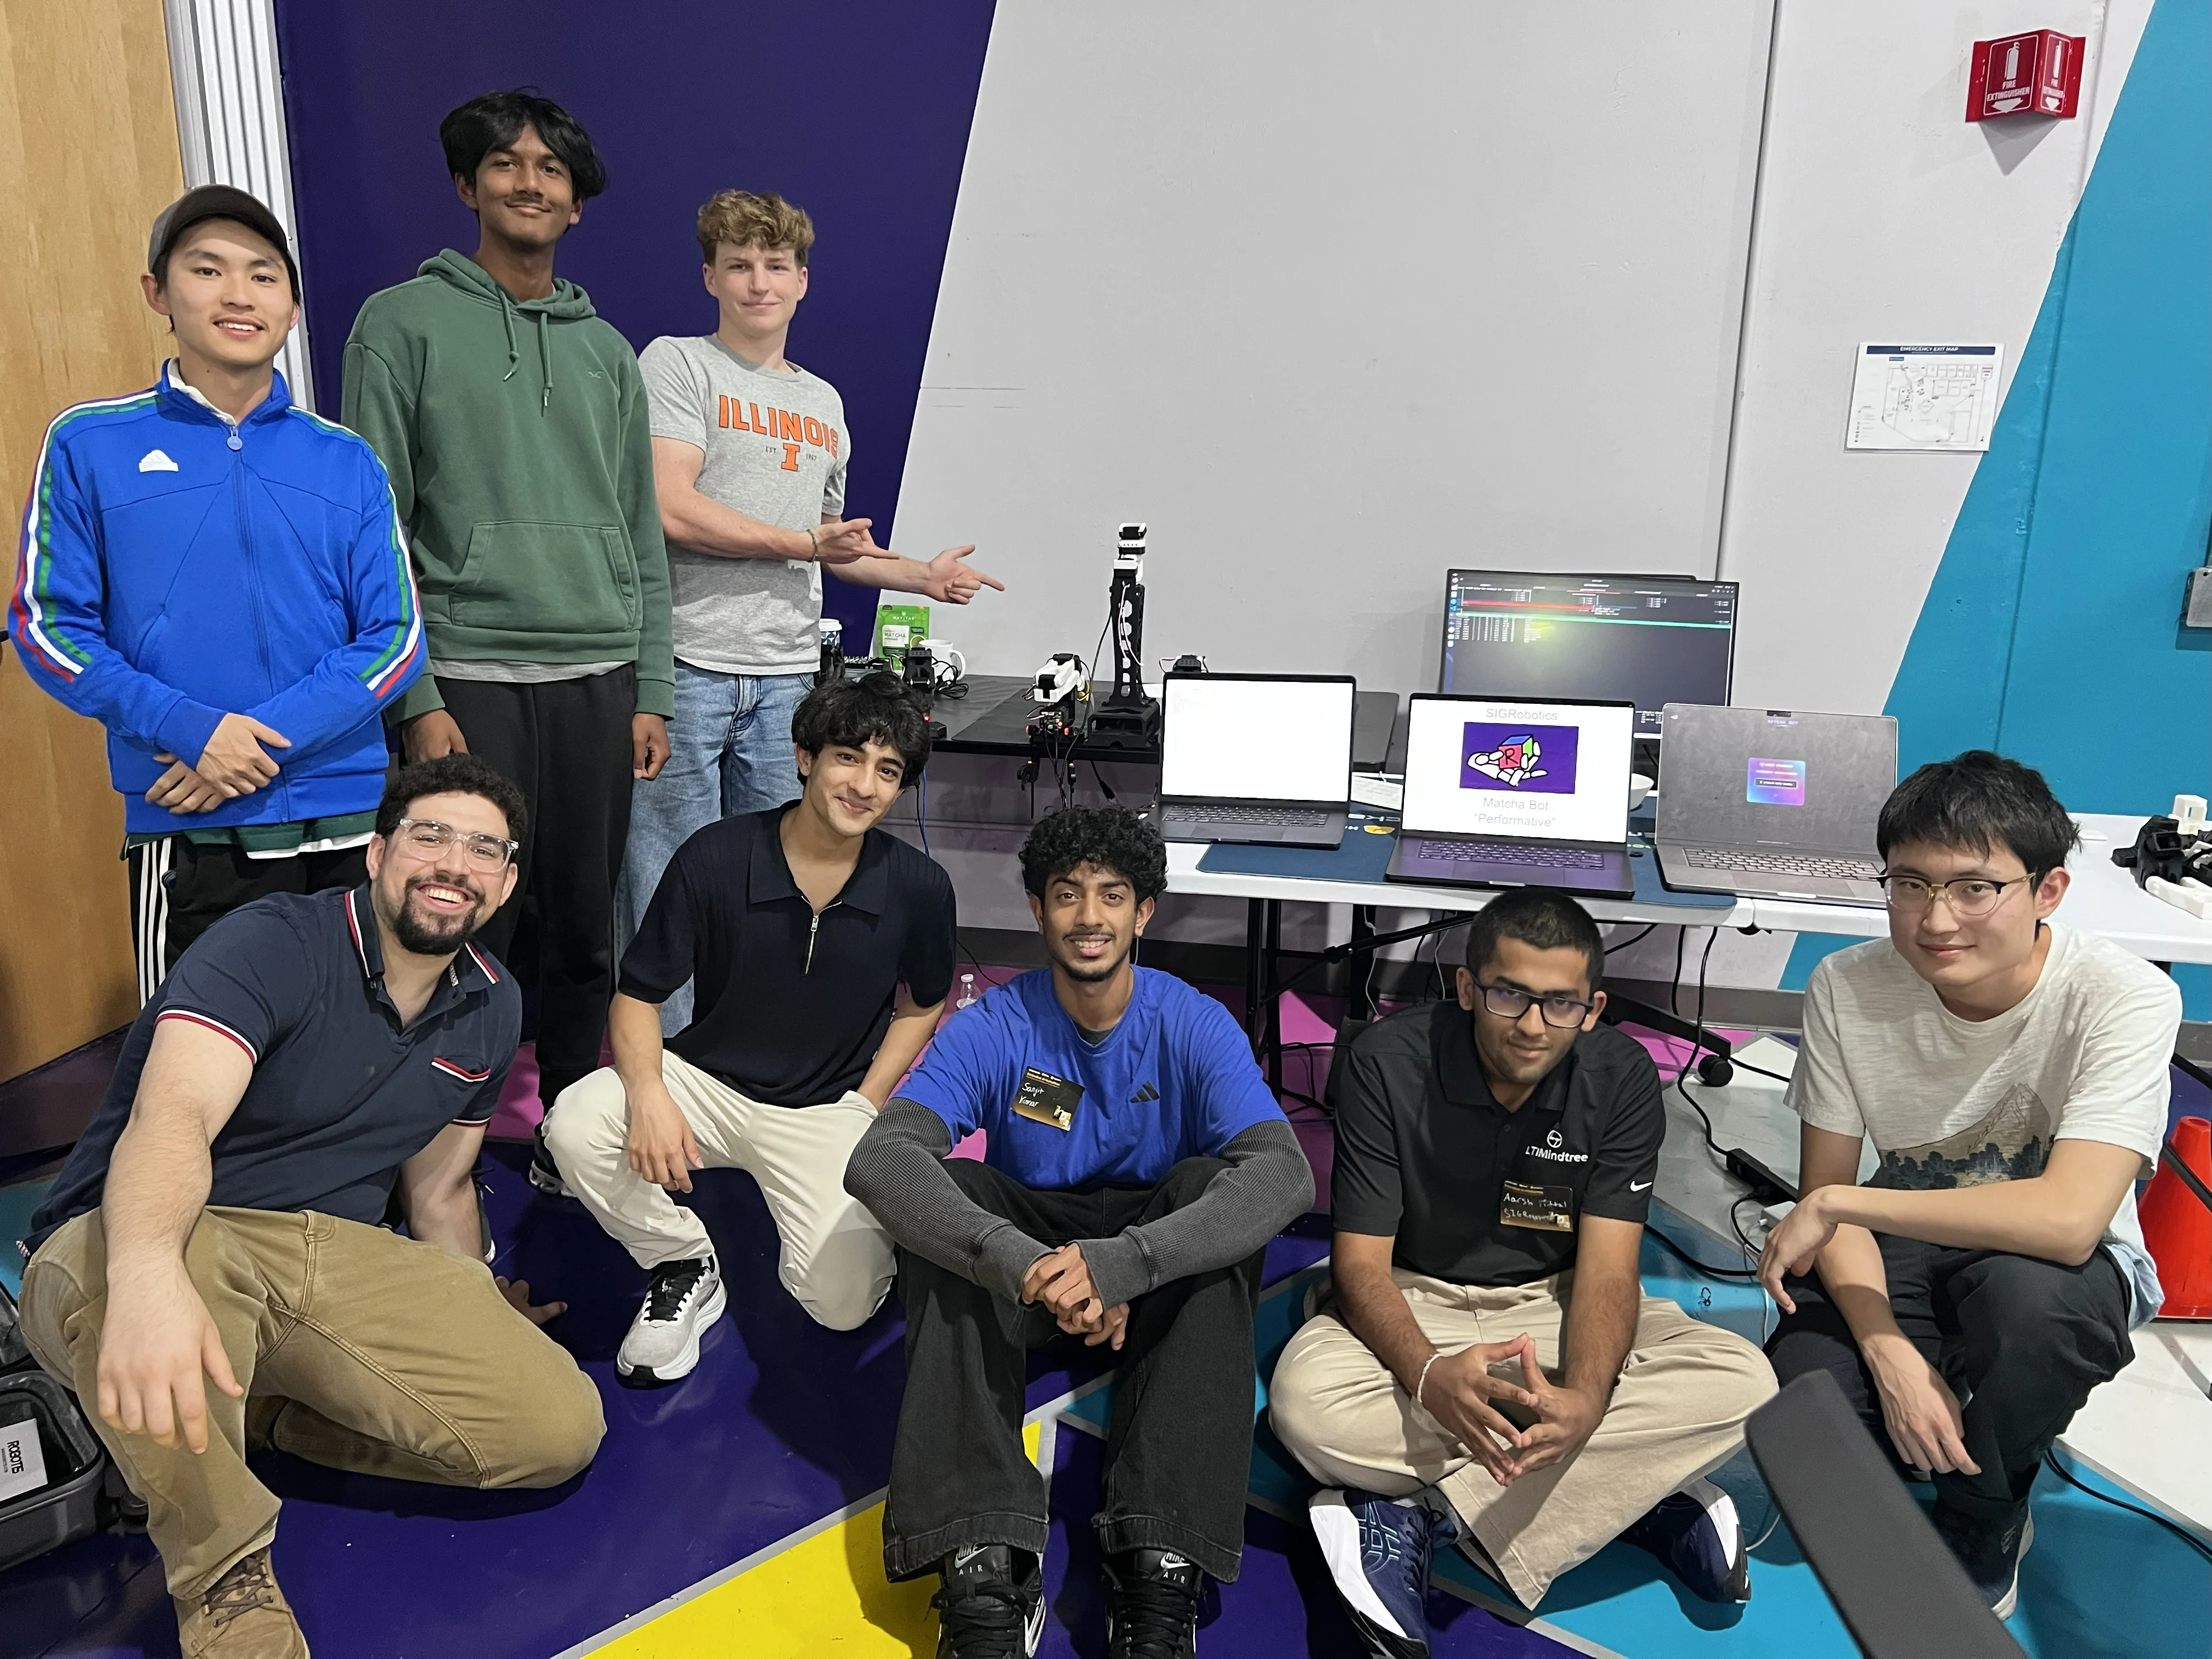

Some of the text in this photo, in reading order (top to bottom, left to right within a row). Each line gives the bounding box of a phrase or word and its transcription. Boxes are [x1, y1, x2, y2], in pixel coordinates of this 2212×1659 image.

[2002, 80, 2017, 89] FIRE
[1987, 87, 2030, 101] EXTINGUISHER
[719, 394, 839, 460] ILLINOIS
[781, 443, 800, 472] I
[1486, 708, 1558, 721] SIGRobotics
[1504, 747, 1519, 765] R
[1483, 798, 1549, 810] Matcha Bot
[1525, 1146, 1589, 1163] LTIMindtree
[7, 1440, 24, 1474] ROBOTIS
[958, 1564, 983, 1576] AIR
[1163, 1571, 1185, 1585] AIR
